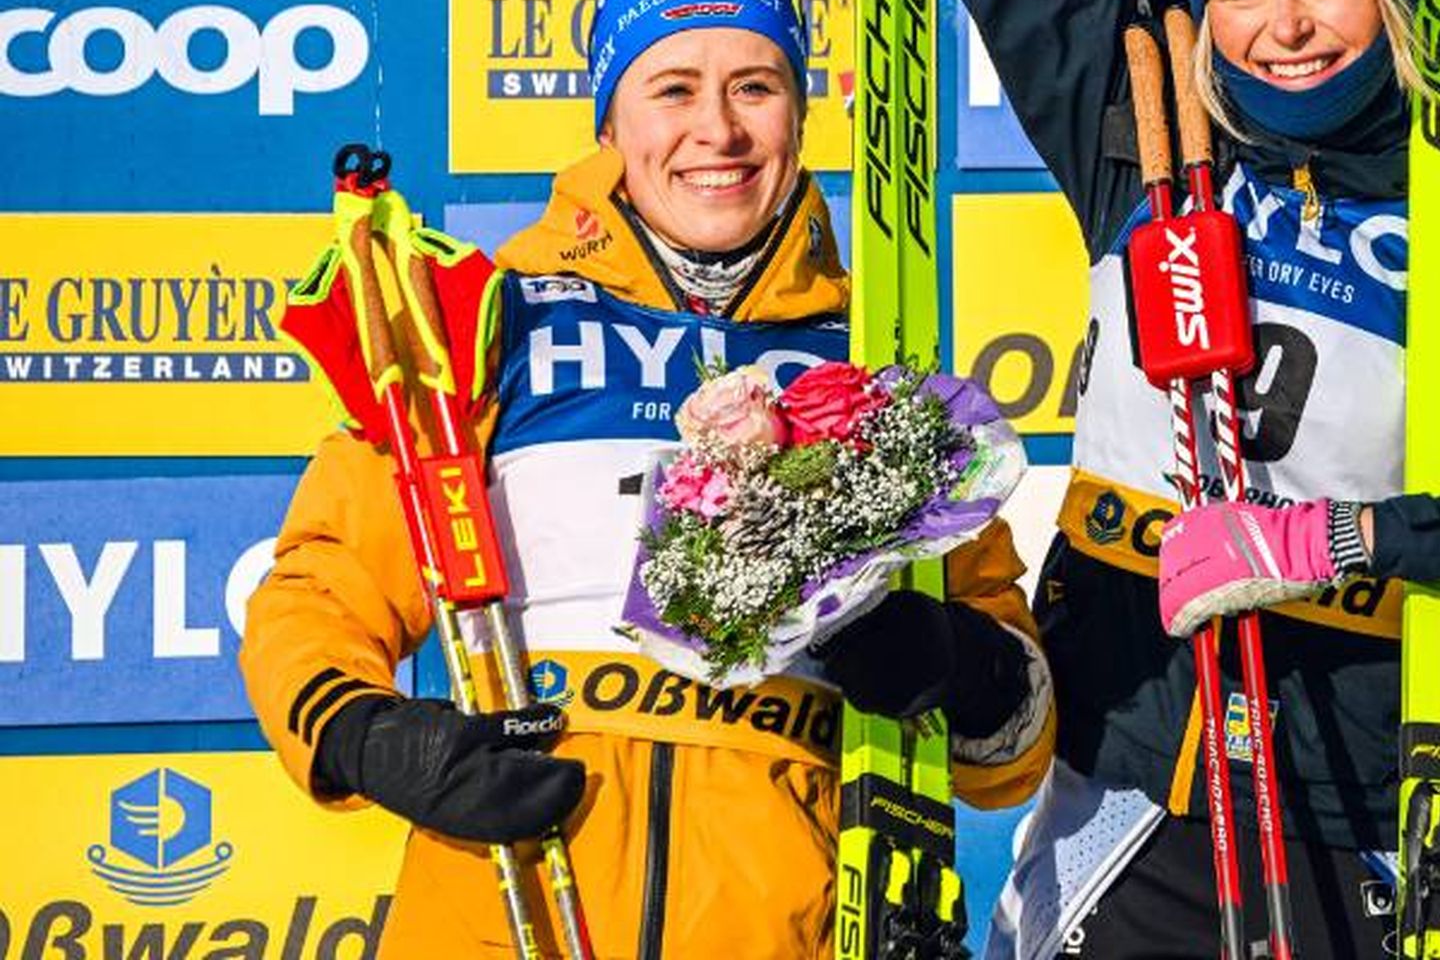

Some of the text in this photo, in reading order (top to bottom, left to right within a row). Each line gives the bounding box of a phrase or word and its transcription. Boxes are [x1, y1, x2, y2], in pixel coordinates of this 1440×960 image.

[0, 4, 369, 115] coop
[46, 262, 302, 343] GRUYÈR
[1268, 260, 1304, 287] DRY
[1308, 273, 1356, 304] EYES
[5, 356, 297, 378] WITZERLAND
[1210, 321, 1318, 463] 9
[632, 401, 671, 421] FOR
[441, 466, 487, 589] LEKI
[0, 896, 393, 960] ßwald
